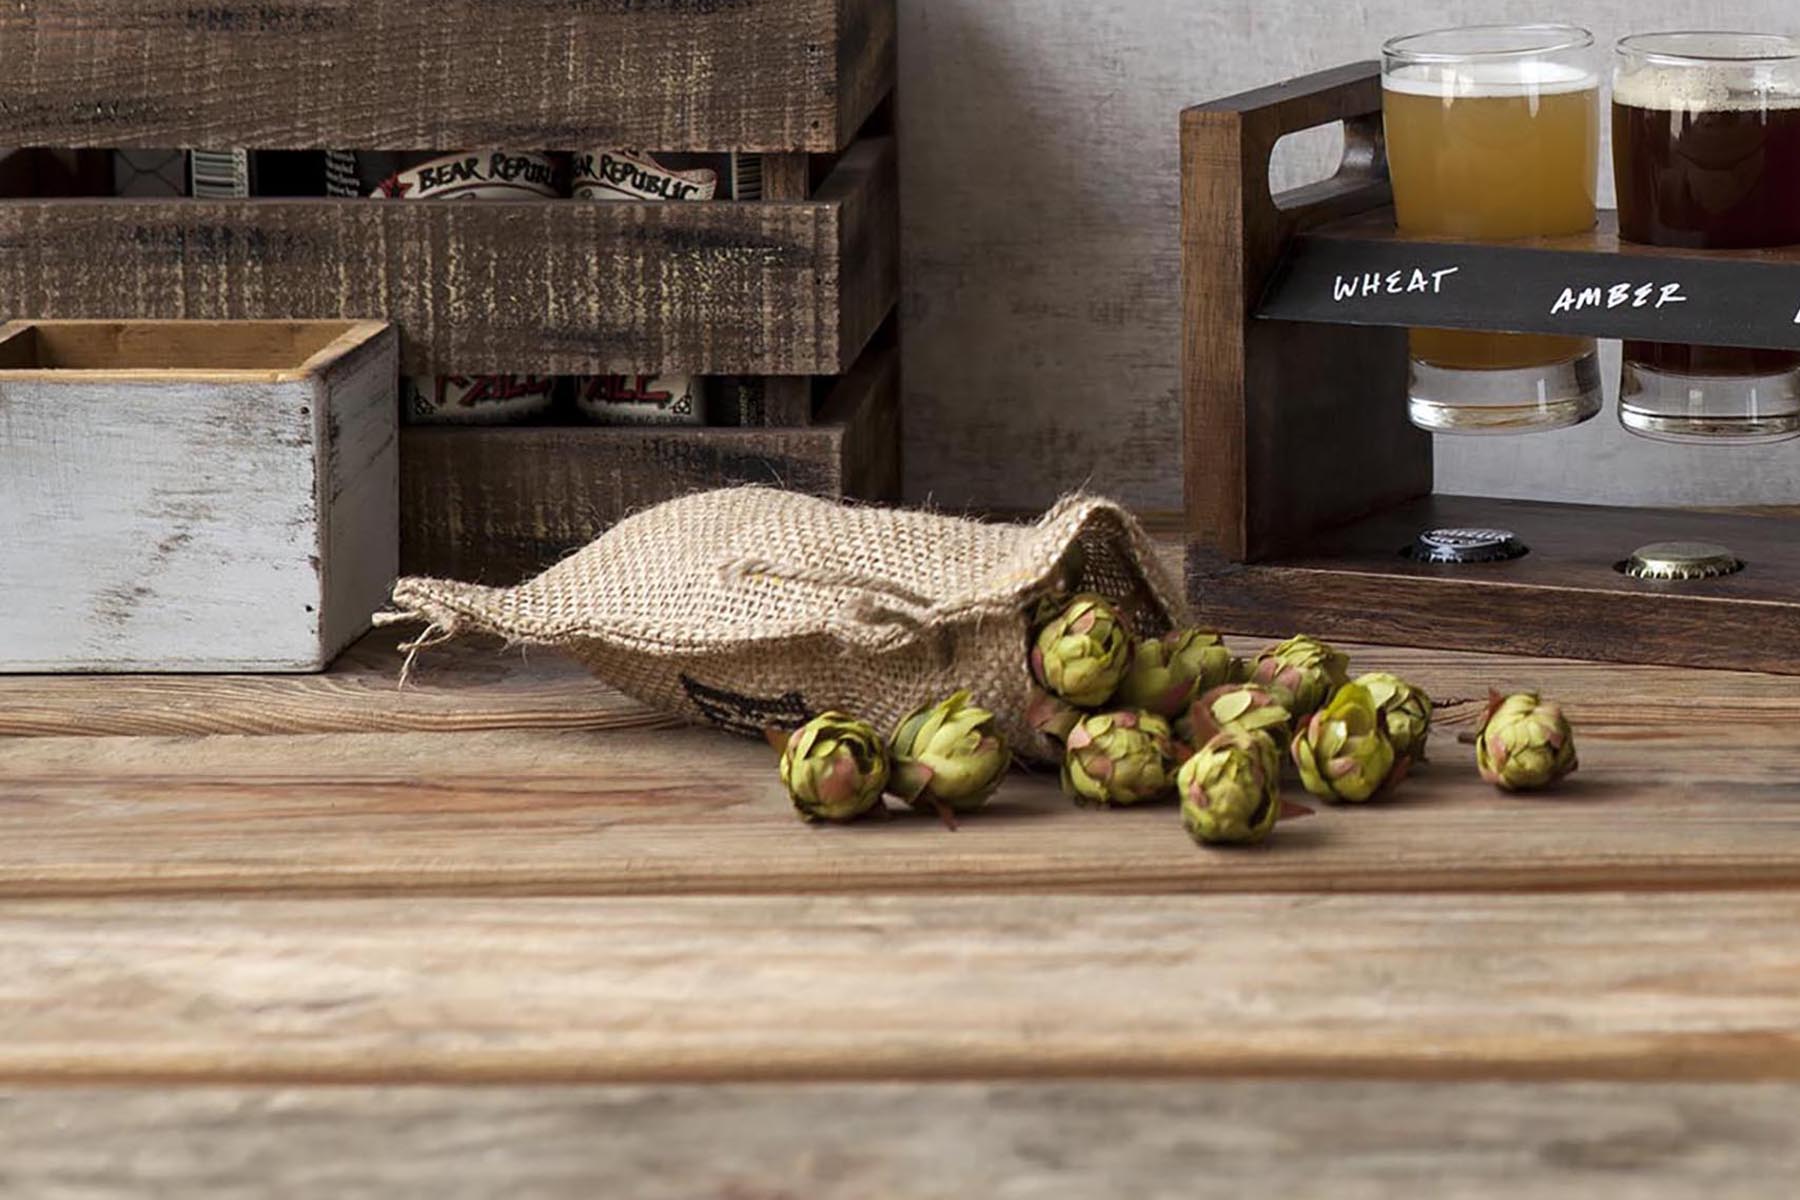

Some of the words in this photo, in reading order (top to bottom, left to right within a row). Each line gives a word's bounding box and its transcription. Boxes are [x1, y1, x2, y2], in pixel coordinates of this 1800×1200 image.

[417, 156, 486, 194] BEAR
[1333, 267, 1459, 301] WHEAT
[1550, 282, 1686, 314] AMBER
